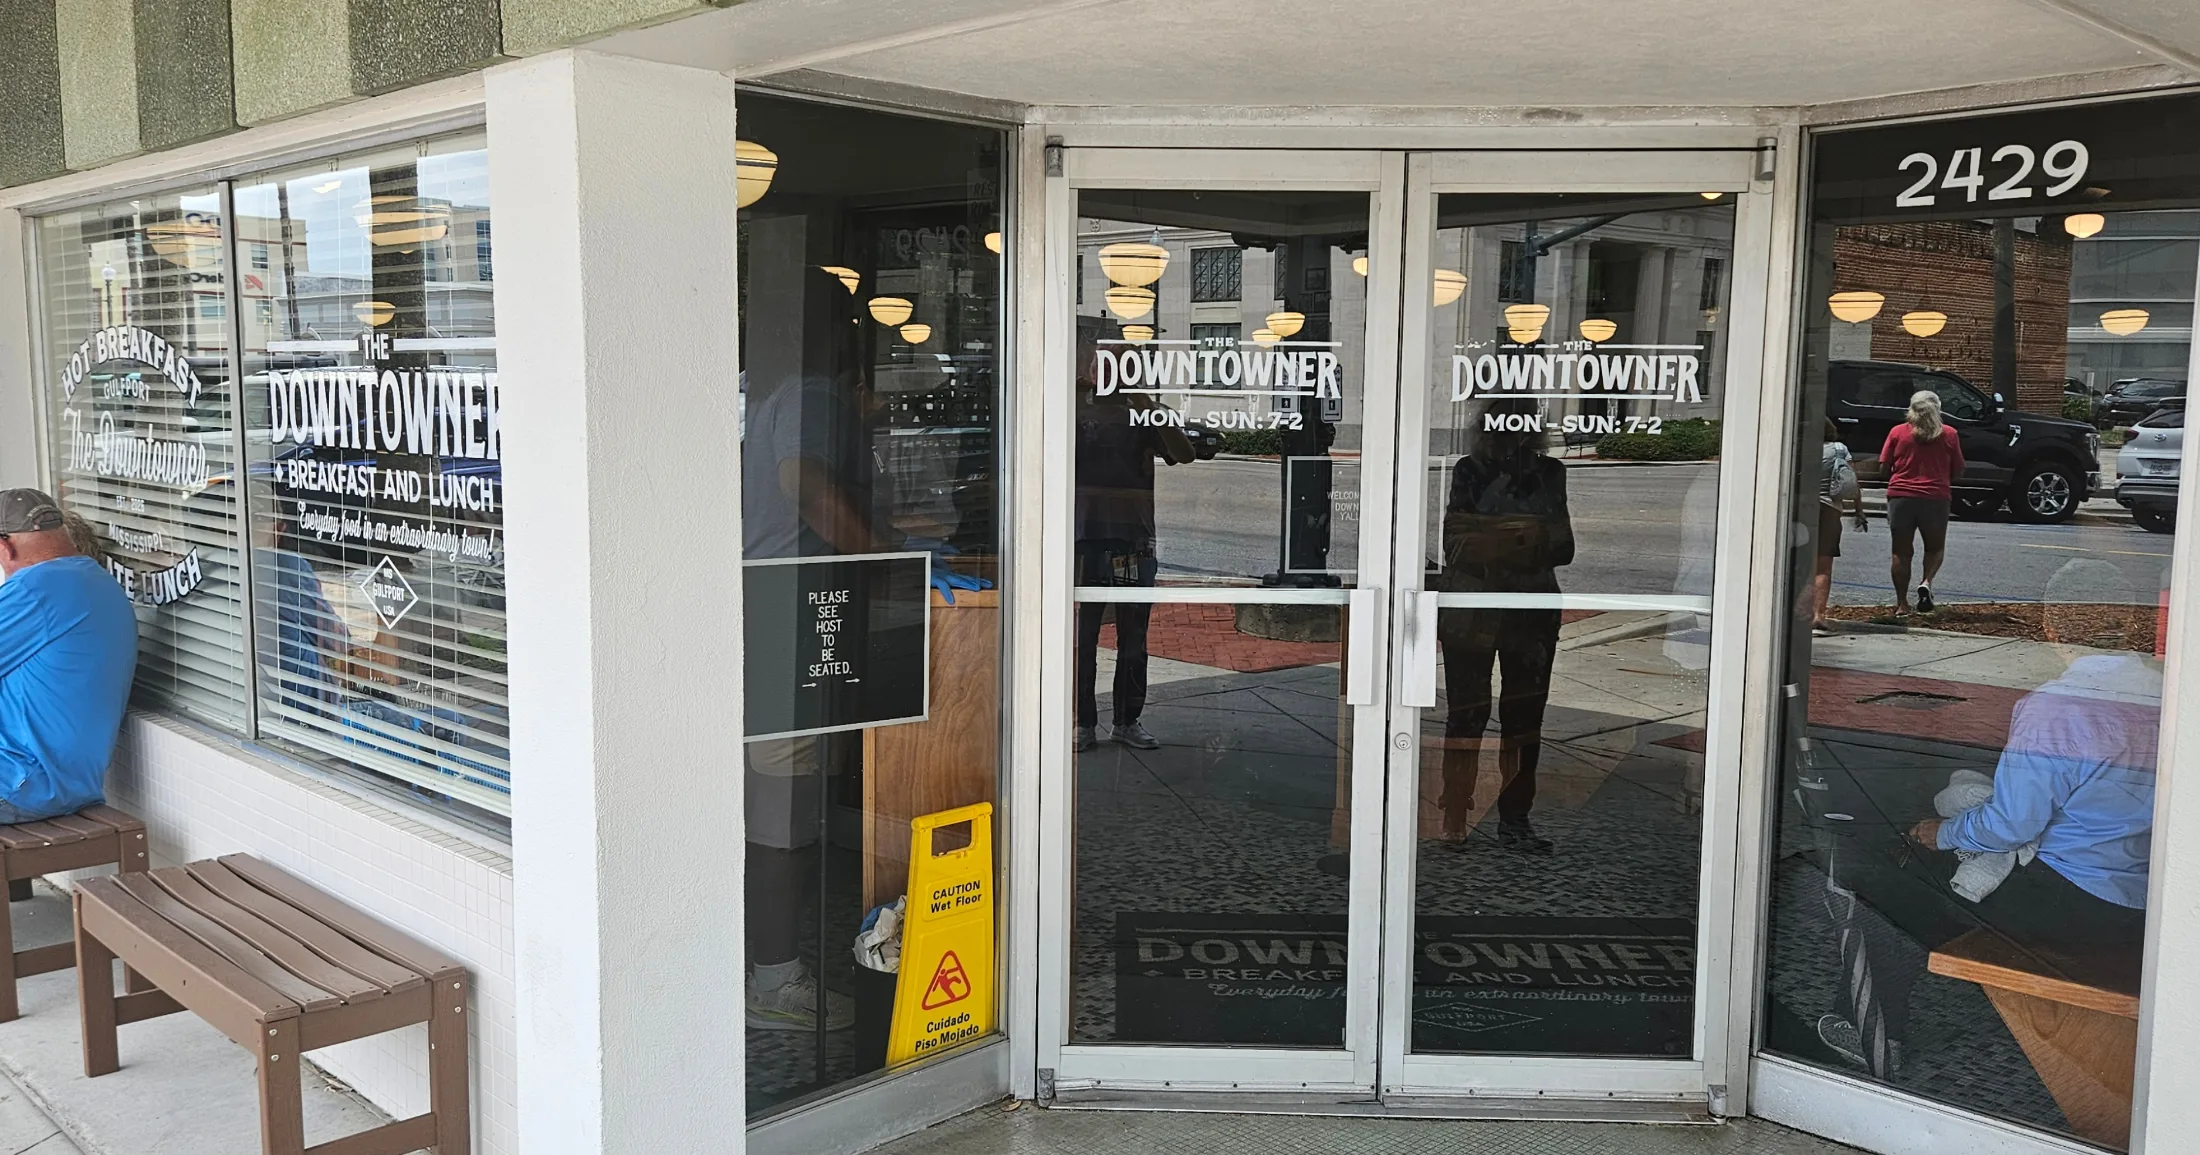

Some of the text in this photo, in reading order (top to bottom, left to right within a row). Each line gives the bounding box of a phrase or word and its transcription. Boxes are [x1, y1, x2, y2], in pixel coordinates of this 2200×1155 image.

[1895, 138, 2090, 208] 2429
[362, 333, 390, 360] THE
[1205, 337, 1235, 347] THE
[1563, 340, 1593, 351] THE
[61, 324, 202, 409] HOT BREAKFAST
[1095, 350, 1342, 399] DOWNTOWNER
[1450, 354, 1703, 403] DOWNTOWNER
[103, 377, 151, 402] GULFPORT
[1267, 411, 1304, 431] 7-2
[1624, 415, 1662, 435] 7-2
[64, 407, 210, 488] The Downtowner
[288, 459, 495, 513] BREAKFAST AND LUNCH
[1327, 491, 1360, 501] WELCOM
[108, 520, 164, 553] MISSISSIPPI
[297, 500, 495, 562] Everyday food in an extraordinary town!
[141, 545, 204, 606] LUNCH
[383, 567, 394, 579] MS
[373, 582, 405, 602] GULFPORT
[808, 590, 850, 605] PLEASE
[383, 604, 396, 617] USA
[817, 605, 839, 619] SEE
[816, 619, 843, 634] HOST
[821, 634, 835, 647] TO
[821, 648, 836, 662] BE
[808, 661, 853, 677] SEATED.
[932, 880, 981, 901] CAUTION
[930, 892, 983, 914] Wet Floor
[1445, 971, 1532, 984] AND
[1208, 983, 1324, 999] Everyday
[926, 1011, 970, 1034] Cuidado
[915, 1024, 980, 1053] Piso Mojado
